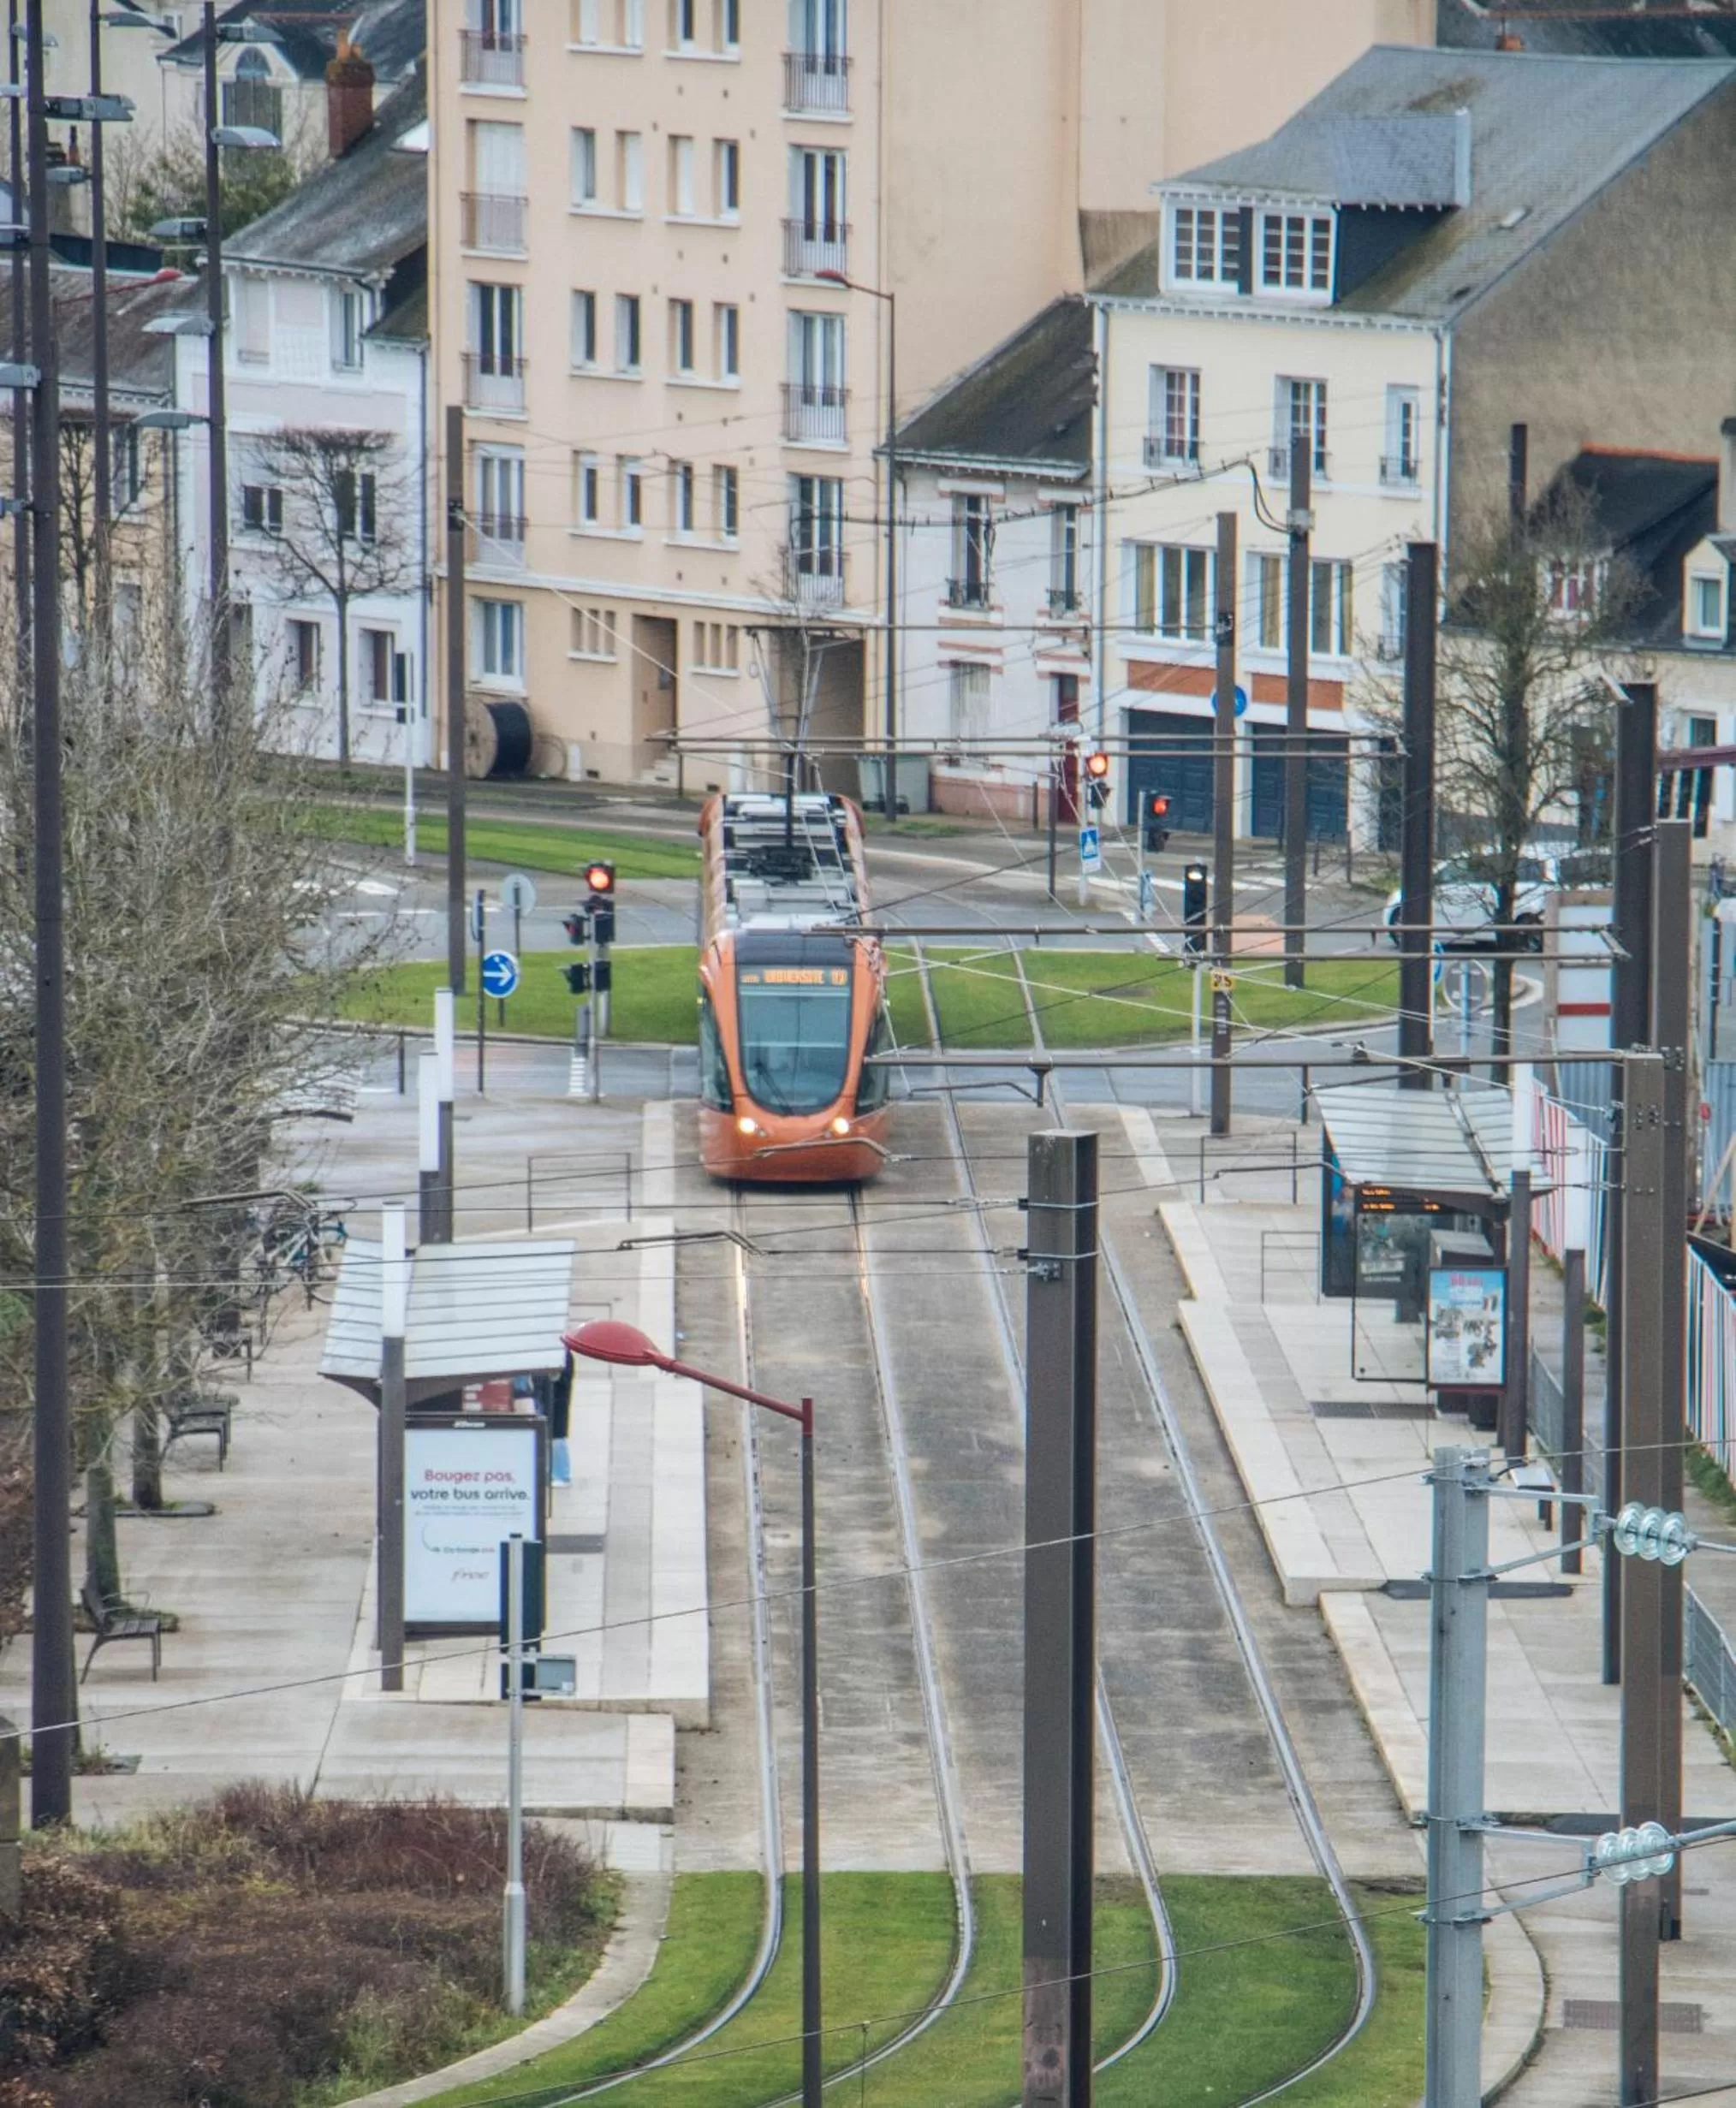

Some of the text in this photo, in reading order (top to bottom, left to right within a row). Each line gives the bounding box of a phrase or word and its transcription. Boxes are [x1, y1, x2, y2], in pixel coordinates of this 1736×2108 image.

[424, 1470, 479, 1484] Bougez
[411, 1487, 531, 1500] votre bus arrive.
